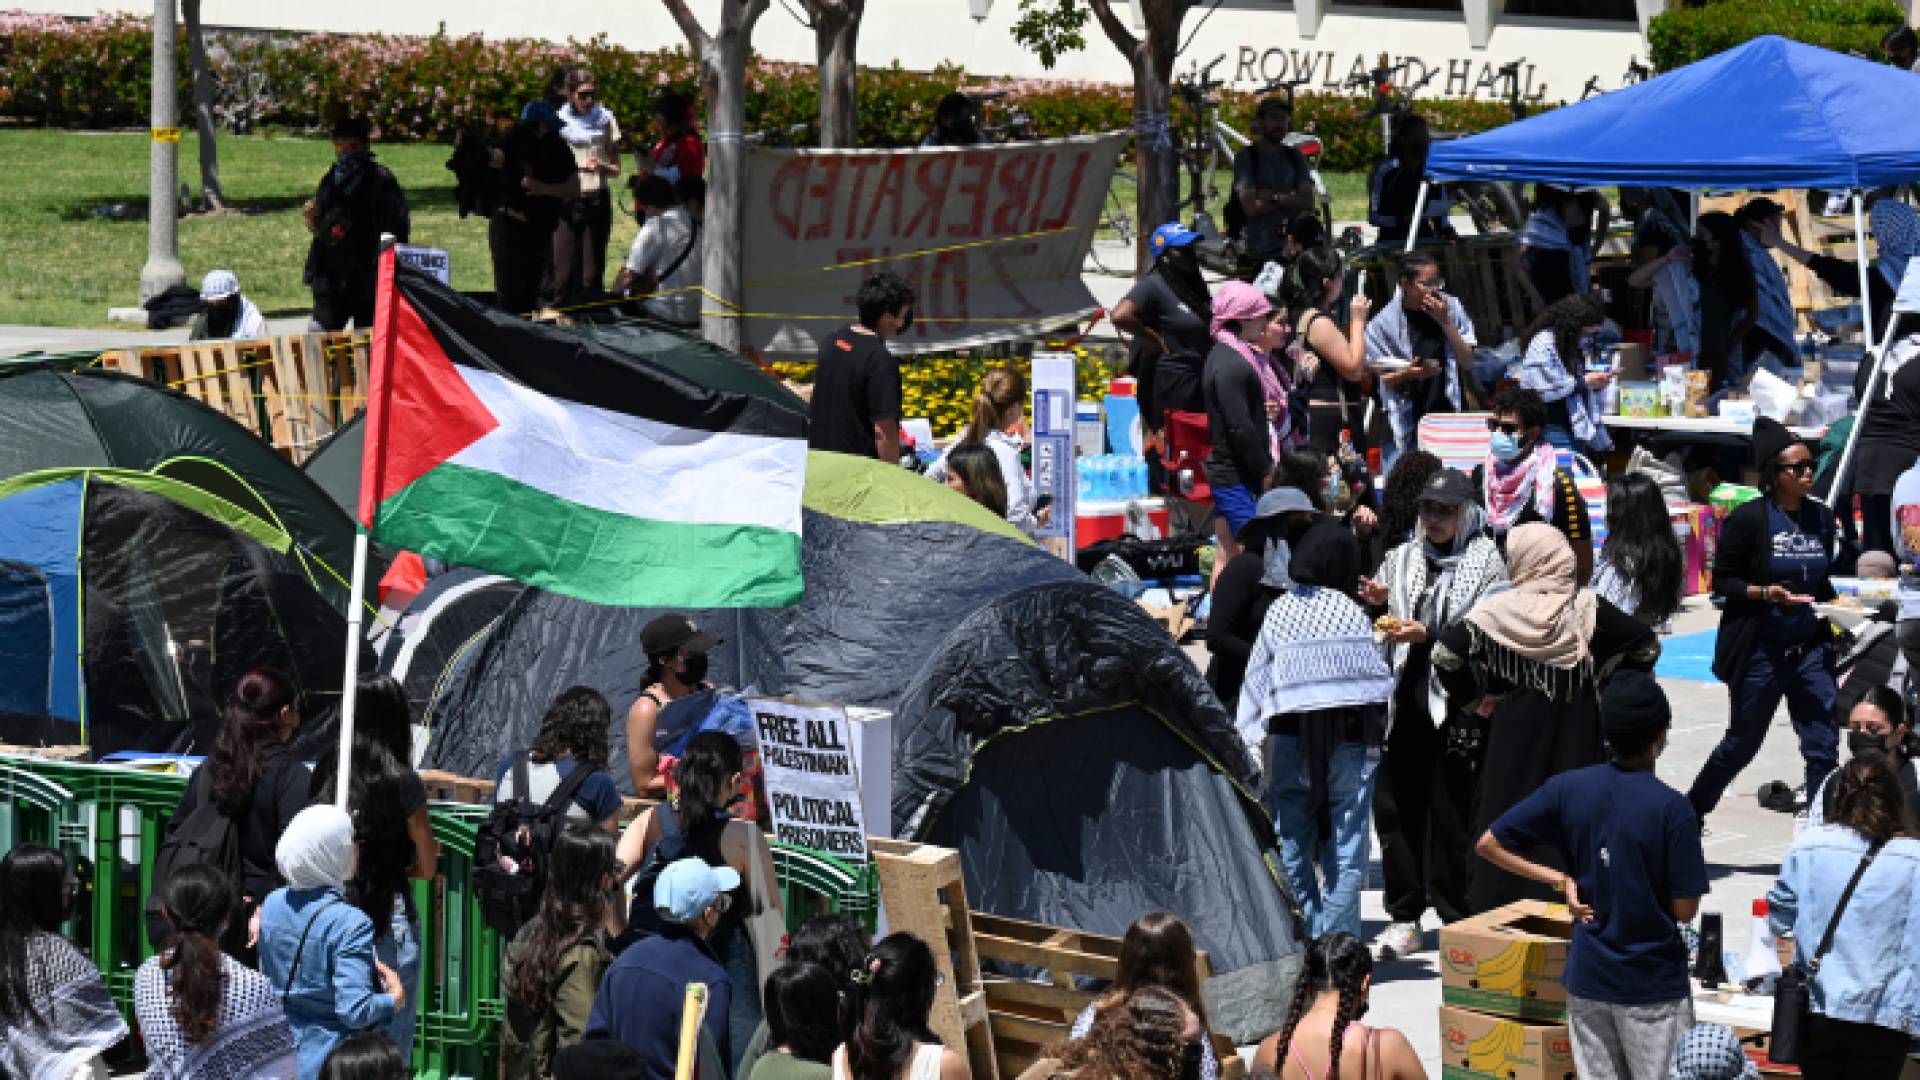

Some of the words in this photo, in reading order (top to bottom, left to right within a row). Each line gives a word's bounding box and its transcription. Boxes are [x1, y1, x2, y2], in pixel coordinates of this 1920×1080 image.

[755, 712, 803, 746] FREE
[805, 719, 846, 750] ALL
[763, 744, 849, 776] PALESTINIAN
[771, 792, 860, 827] POLITICAL
[777, 822, 863, 854] PRISONERS
